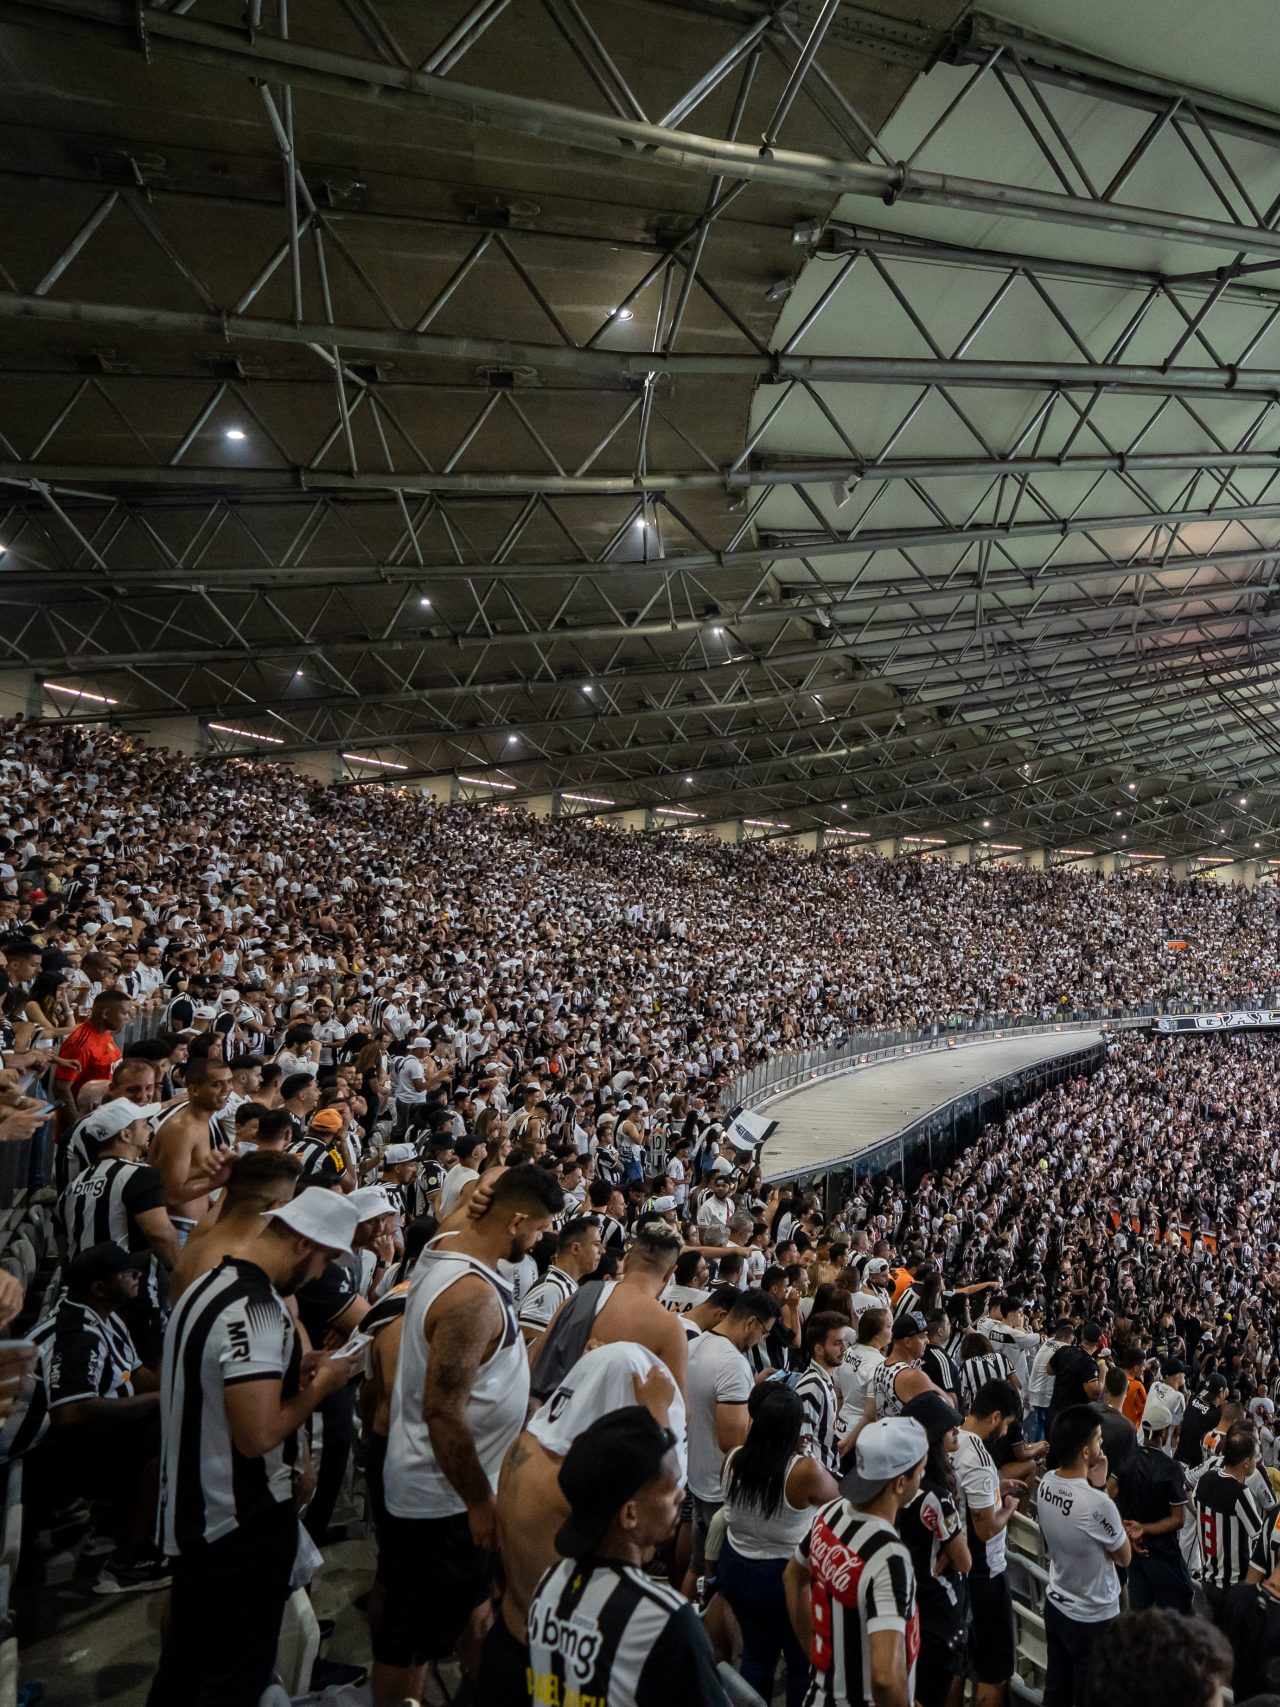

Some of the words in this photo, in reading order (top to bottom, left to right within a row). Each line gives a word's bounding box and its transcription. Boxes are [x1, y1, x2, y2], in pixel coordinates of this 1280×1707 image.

[73, 1180, 104, 1198] bmg
[226, 1321, 250, 1361] MR
[845, 1353, 862, 1373] bmg
[1195, 1401, 1210, 1415] bmg
[1045, 1486, 1073, 1516] bmg
[1059, 1488, 1073, 1498] GALO
[542, 1606, 598, 1679] bmg
